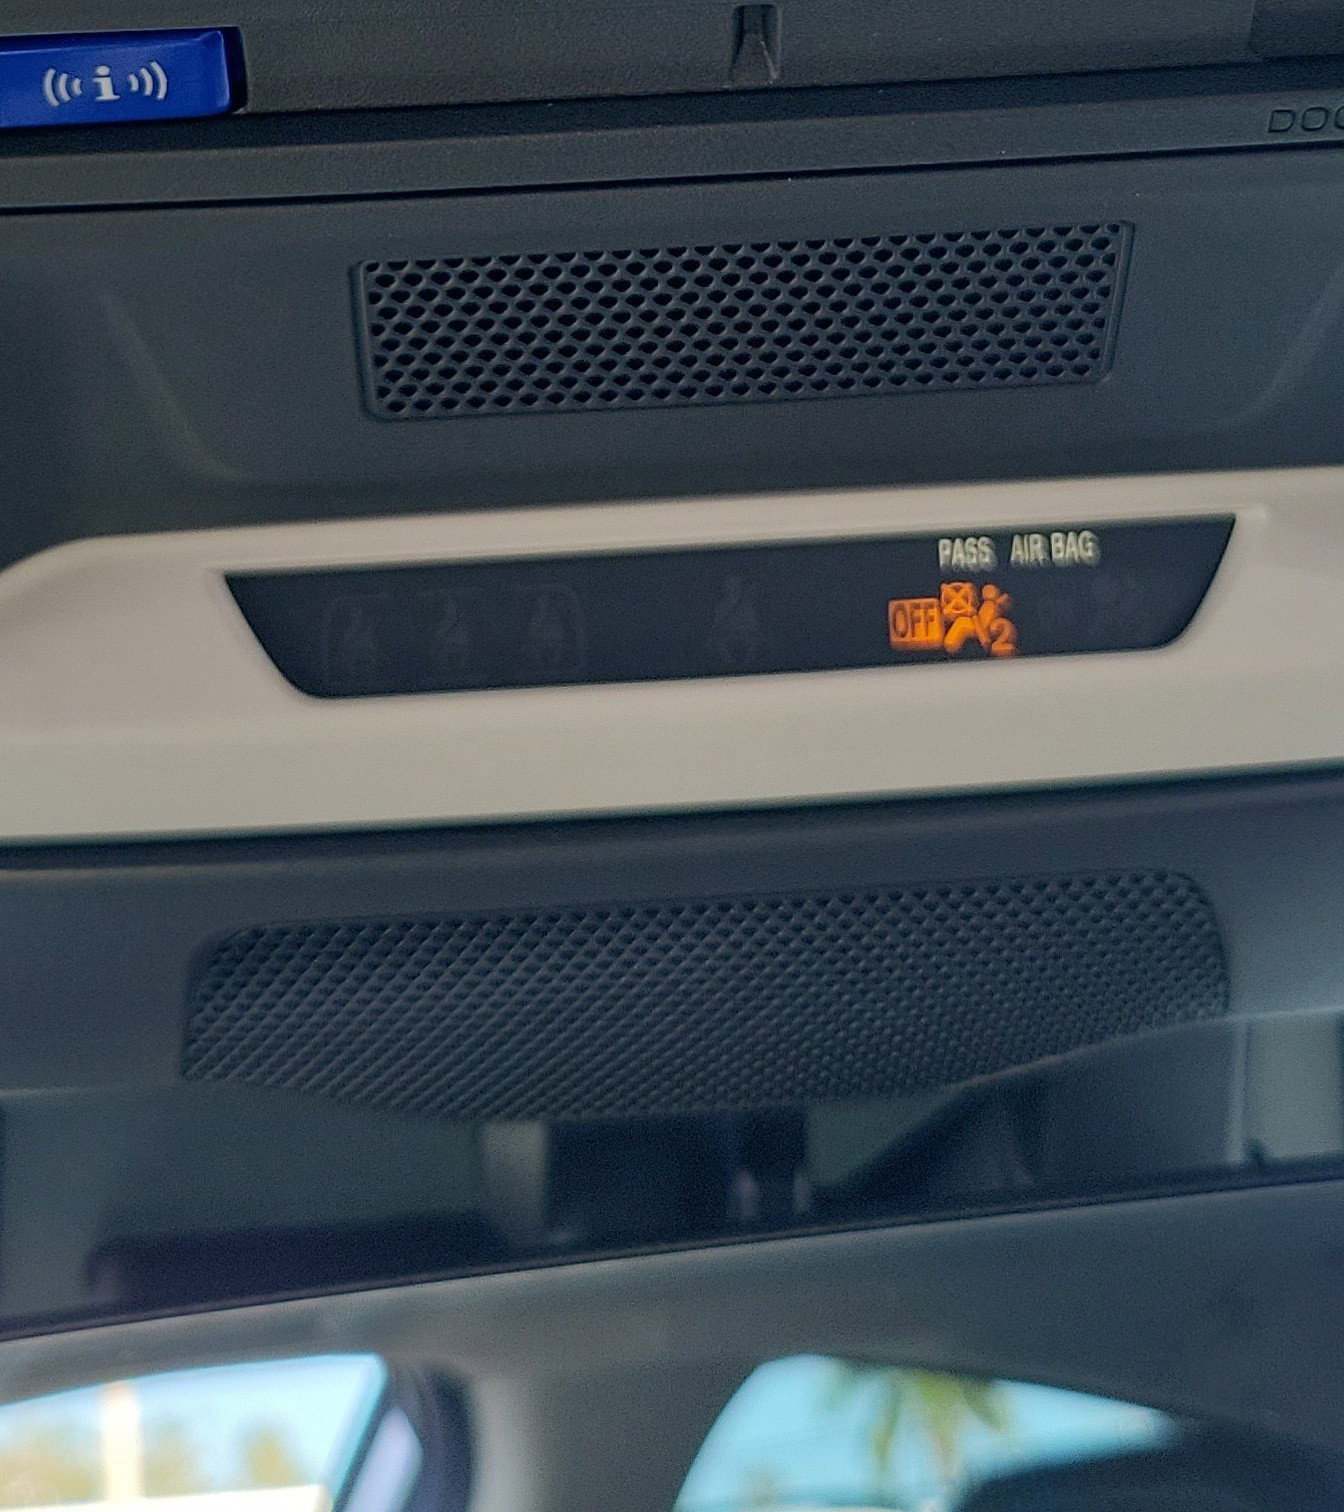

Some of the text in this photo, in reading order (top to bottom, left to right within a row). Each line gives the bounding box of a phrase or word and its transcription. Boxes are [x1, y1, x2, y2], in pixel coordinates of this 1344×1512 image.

[939, 530, 1097, 569] PASS AIR BAG
[892, 604, 937, 639] OFF
